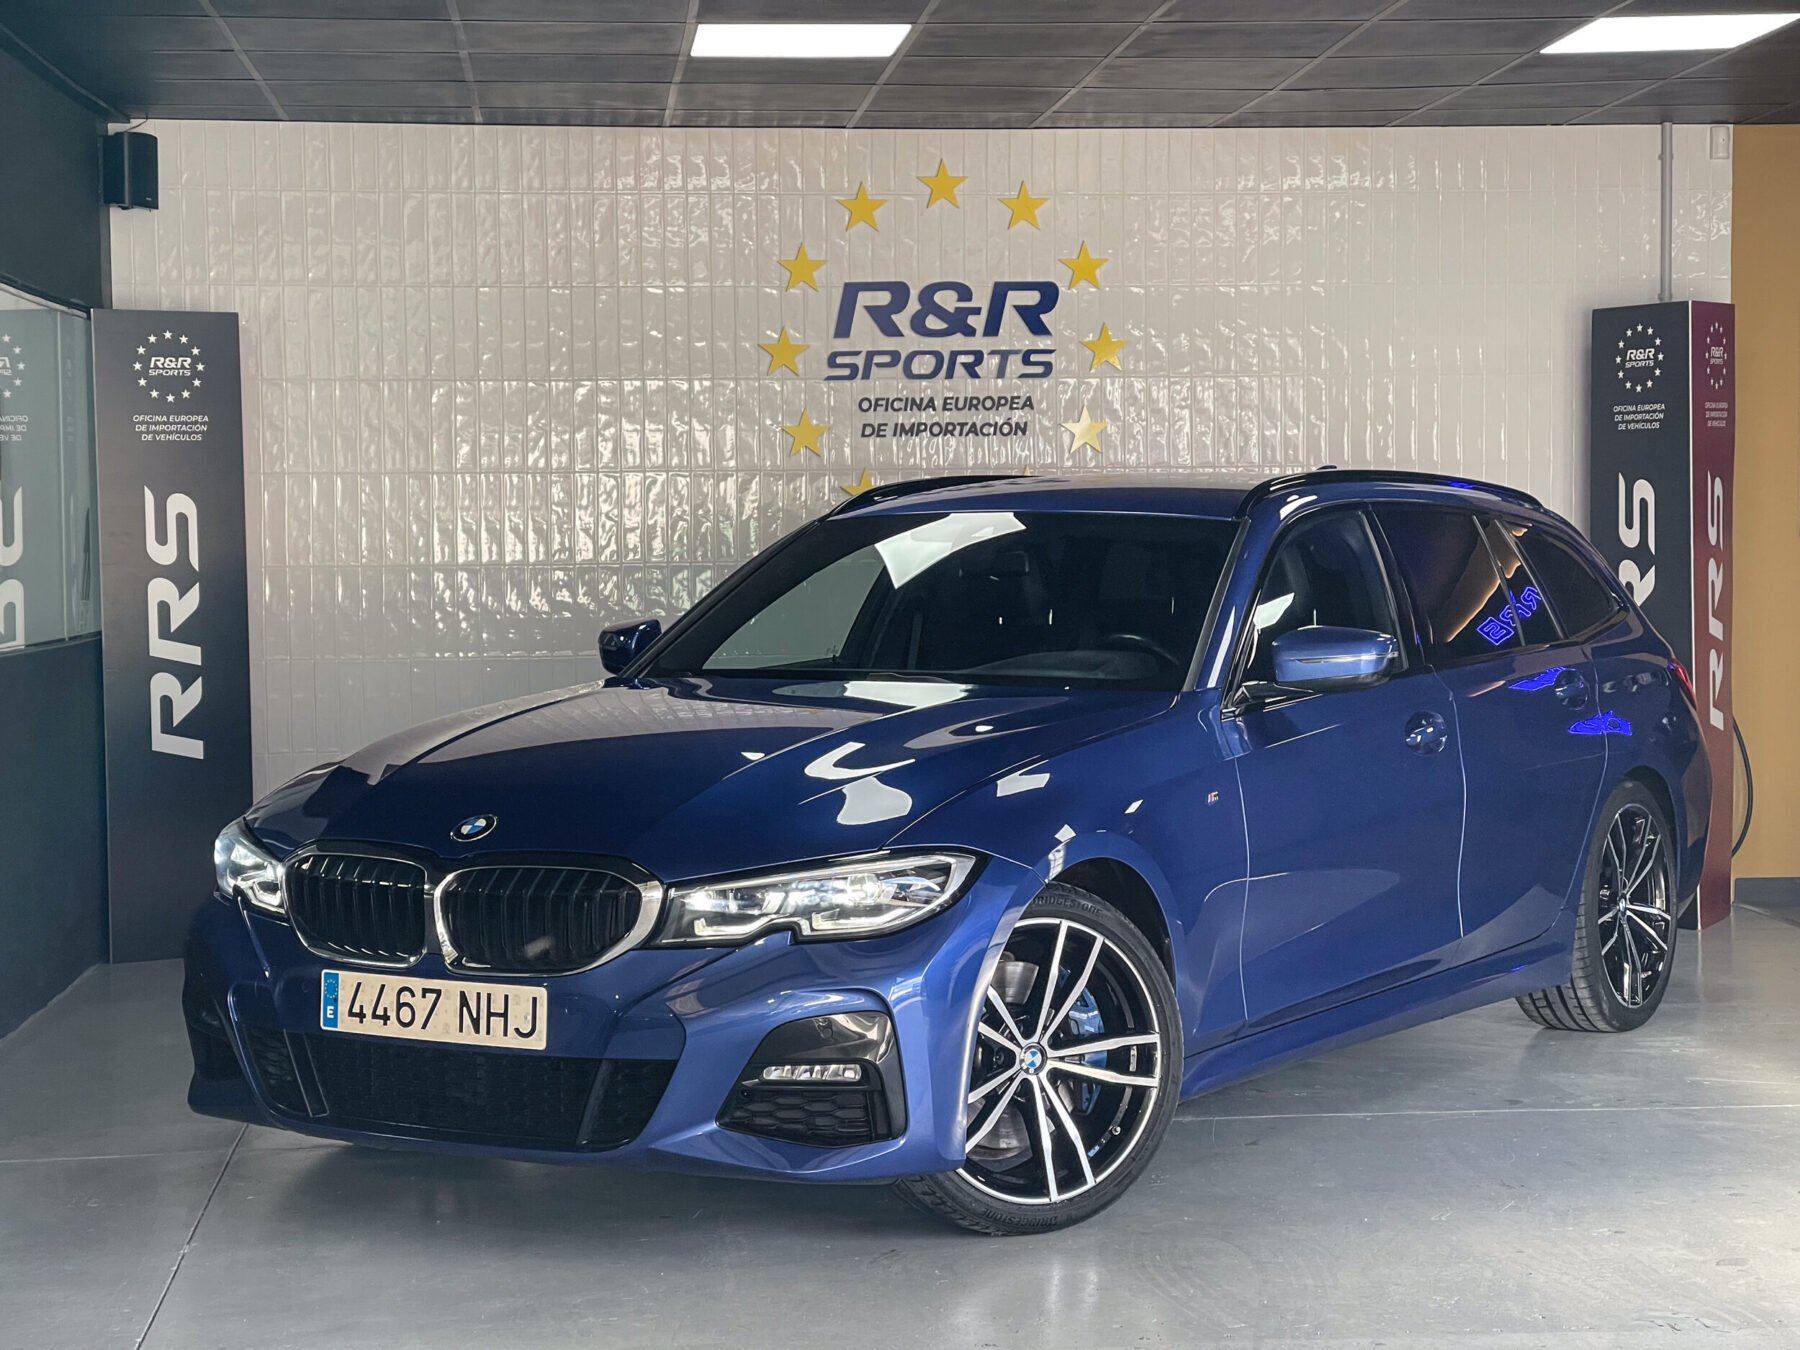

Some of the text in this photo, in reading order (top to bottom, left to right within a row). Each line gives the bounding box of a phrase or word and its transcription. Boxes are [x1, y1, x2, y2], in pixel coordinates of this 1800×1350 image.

[833, 281, 1060, 338] R&R
[1626, 348, 1655, 361] R&R
[150, 357, 192, 369] R&R
[824, 349, 1057, 381] SPORTS
[1625, 359, 1655, 368] SPORTS
[148, 369, 192, 377] SPORTS
[858, 395, 1035, 412] OFICINA EUROPEA
[1613, 403, 1666, 413] OFICINA EUROPEA
[132, 414, 209, 422] OFICINA EUROPEA
[1623, 411, 1665, 421] IMPORTACIÓN
[135, 423, 208, 432] DE IMPORTACIÓN
[861, 418, 1028, 438] DE IMPORTACIÓN
[141, 432, 202, 441] DE VEHÍCULOS
[1707, 470, 1724, 731] RRS
[144, 485, 204, 759] RRS
[326, 981, 538, 1039] E 4467 NHJ
